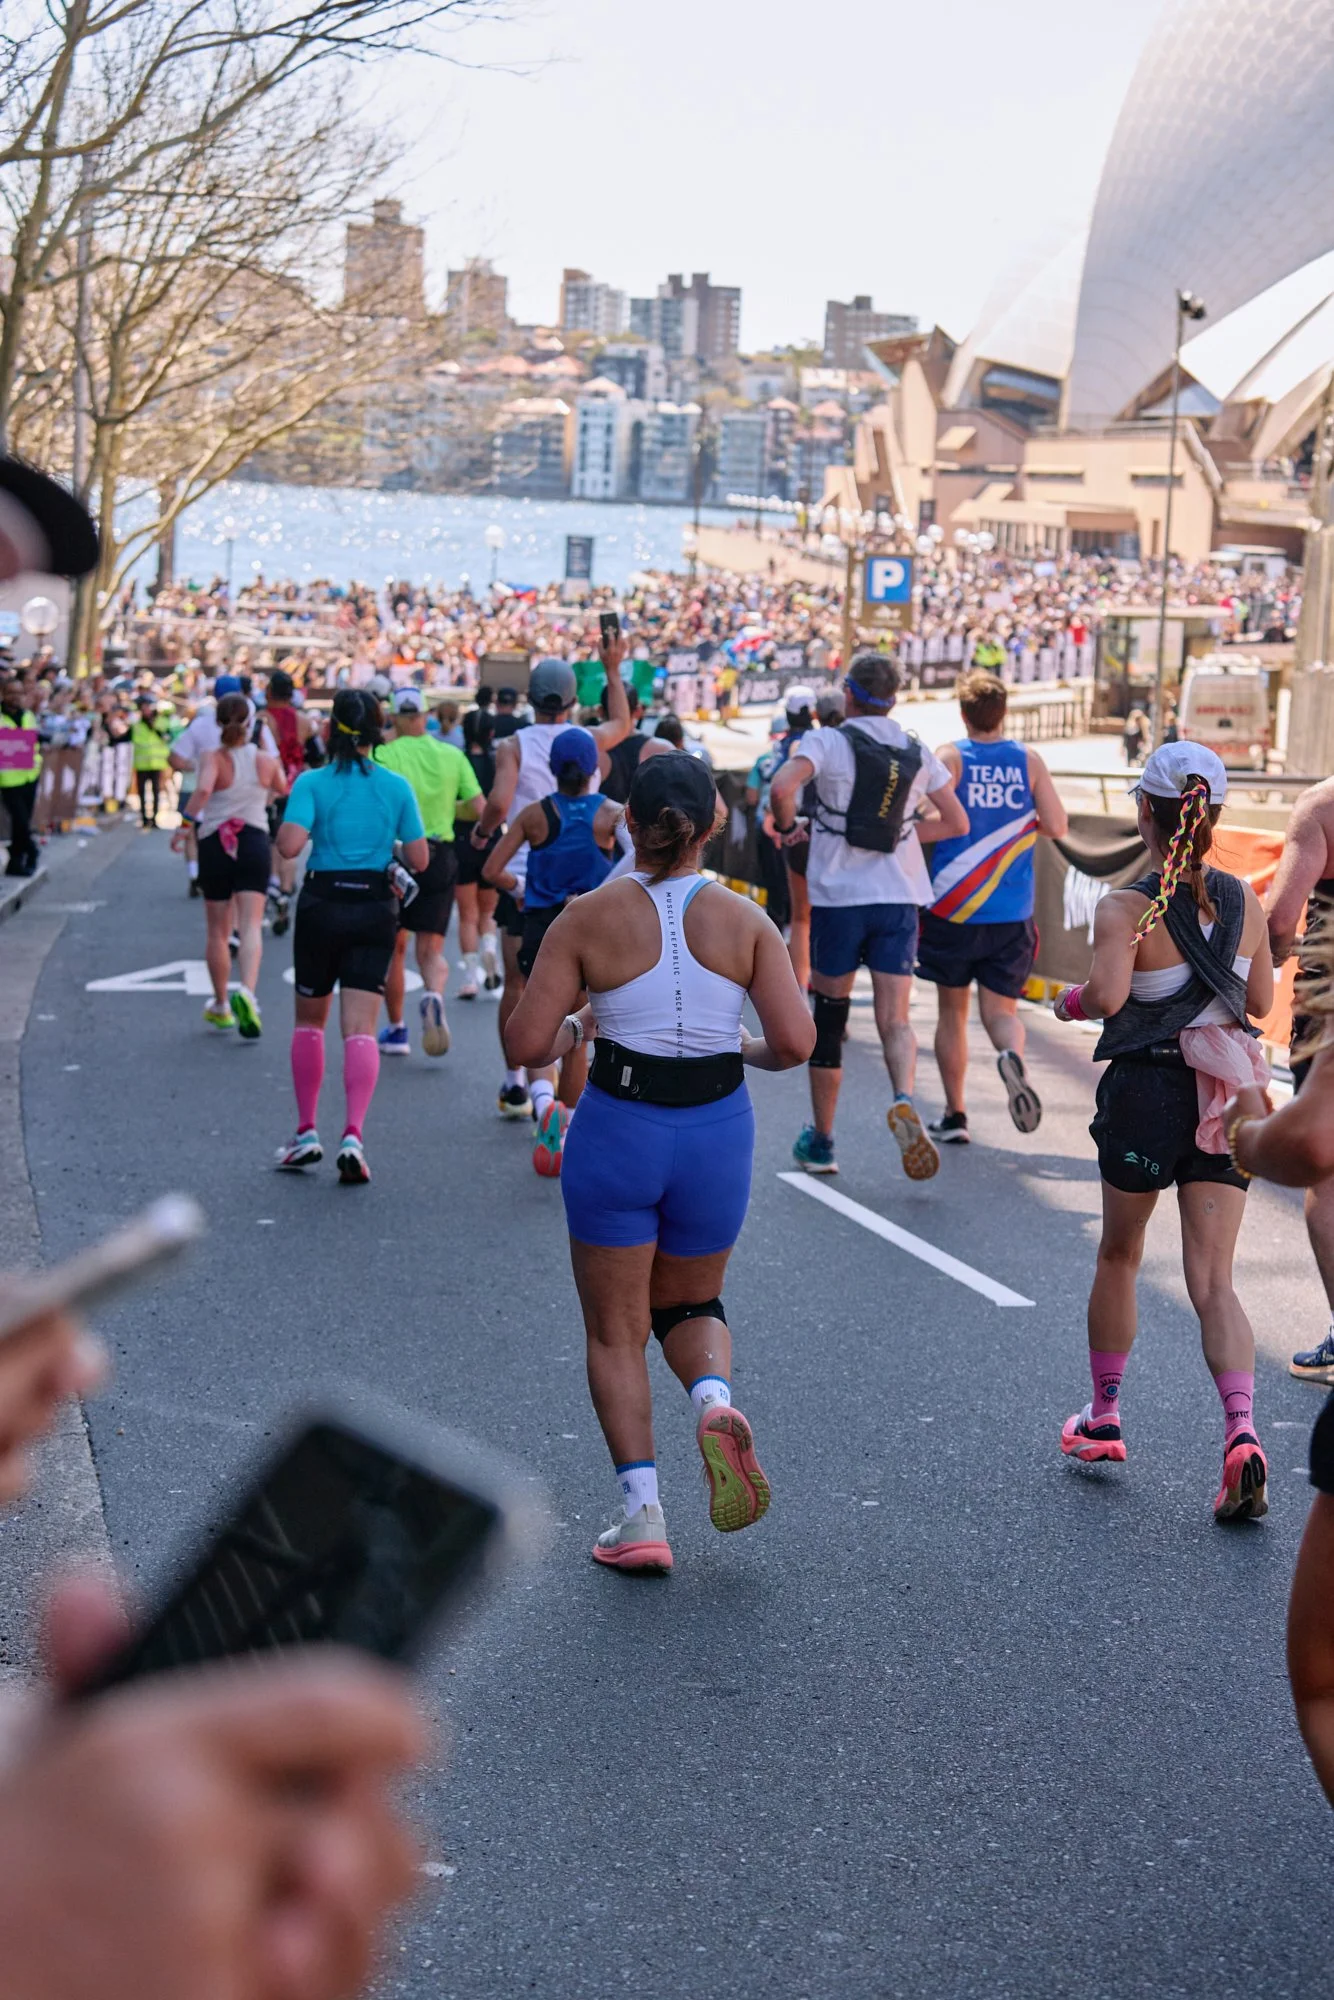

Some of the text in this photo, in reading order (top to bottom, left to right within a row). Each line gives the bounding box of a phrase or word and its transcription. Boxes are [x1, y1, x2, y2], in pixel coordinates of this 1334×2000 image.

[872, 560, 905, 598] P
[878, 759, 900, 817] NATHAN
[968, 765, 1024, 783] TEAM
[967, 782, 1025, 810] RBC
[666, 892, 675, 926] MUSCLE
[670, 931, 680, 976] REPUBLIC
[1142, 1156, 1160, 1175] T8
